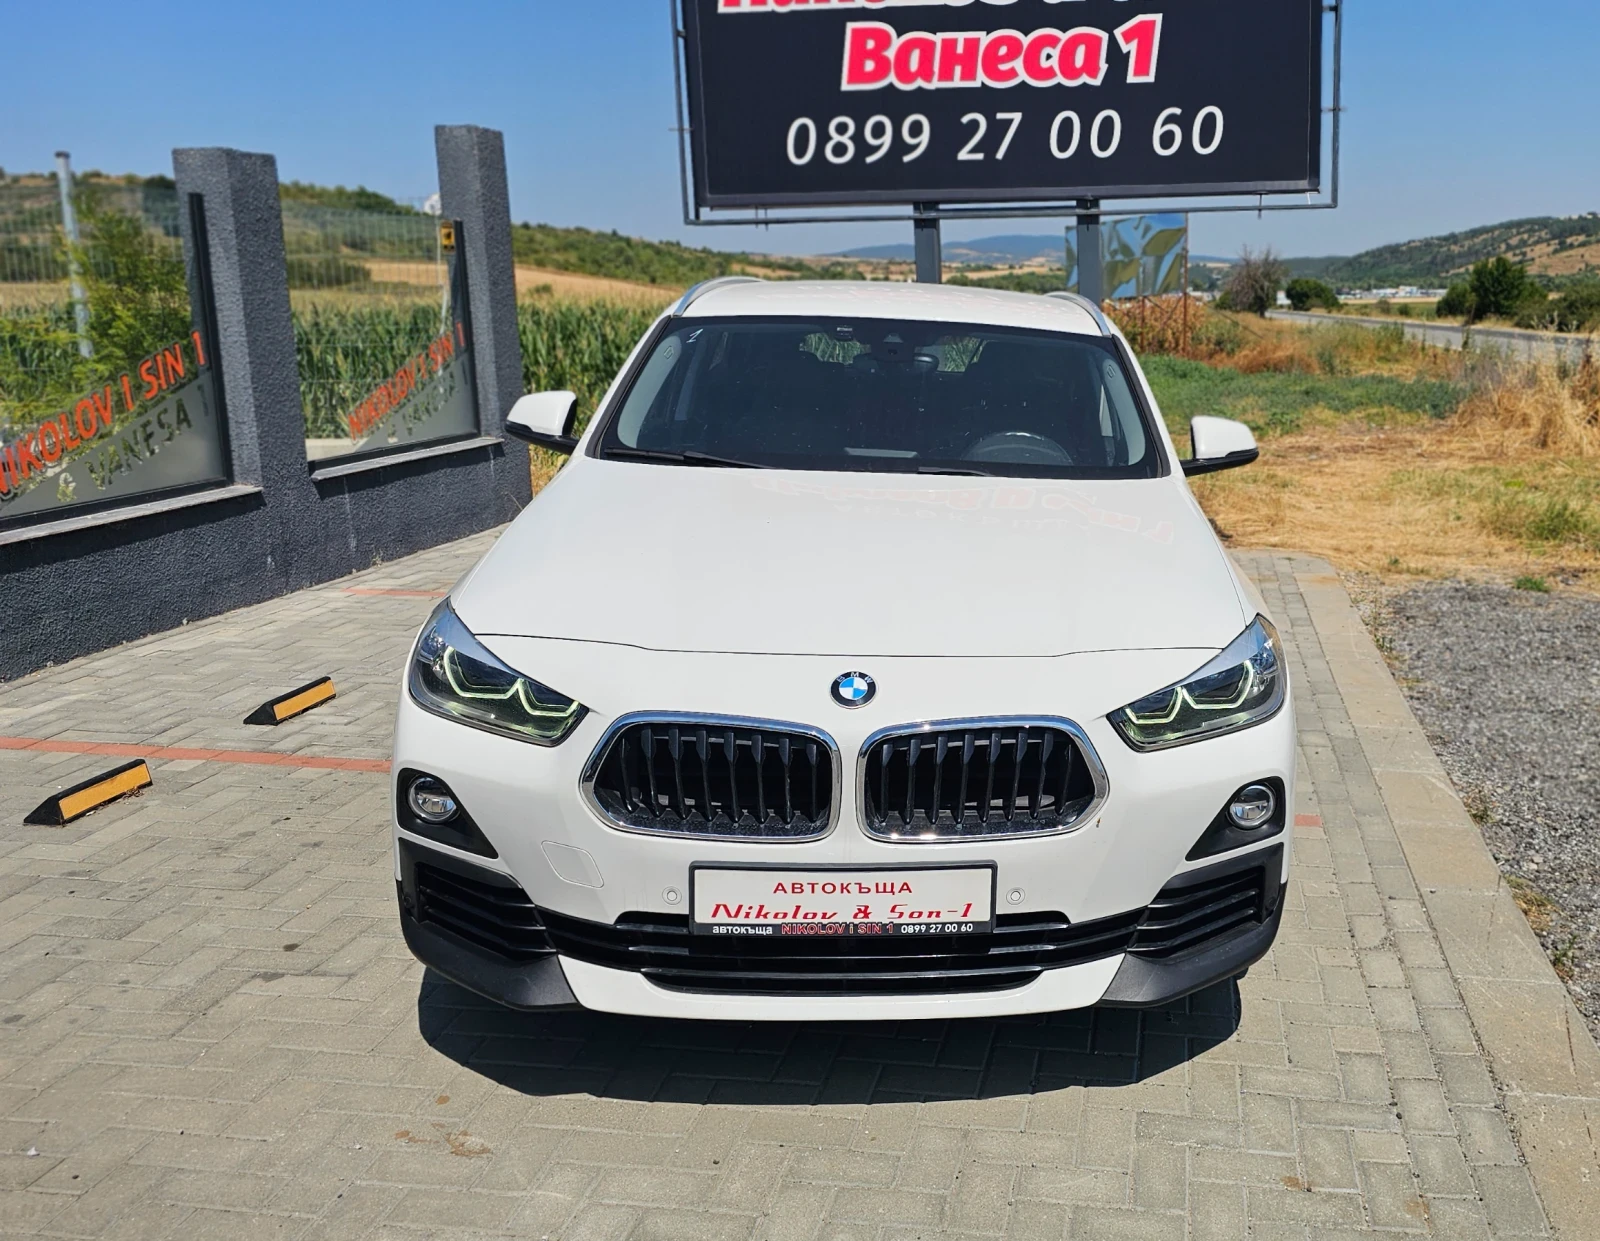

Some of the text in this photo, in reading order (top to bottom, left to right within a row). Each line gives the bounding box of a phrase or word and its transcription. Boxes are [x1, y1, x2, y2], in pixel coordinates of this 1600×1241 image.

[842, 13, 1162, 90] Ванеса 1
[786, 105, 1224, 165] 0899 27 00 60
[140, 342, 185, 400] SIN
[347, 359, 416, 442] NIKOLOV
[428, 331, 454, 373] SIN
[85, 397, 193, 490] VANESA
[836, 671, 874, 684] BMW
[772, 881, 913, 896] АВТОКЪЩА
[711, 902, 973, 920] Nikolov & Son-1
[712, 925, 773, 935] автокъща
[780, 922, 846, 935] NIKOLOV
[857, 923, 882, 935] SIN
[886, 922, 894, 934] 1
[900, 923, 973, 934] 0899 27 00 60
